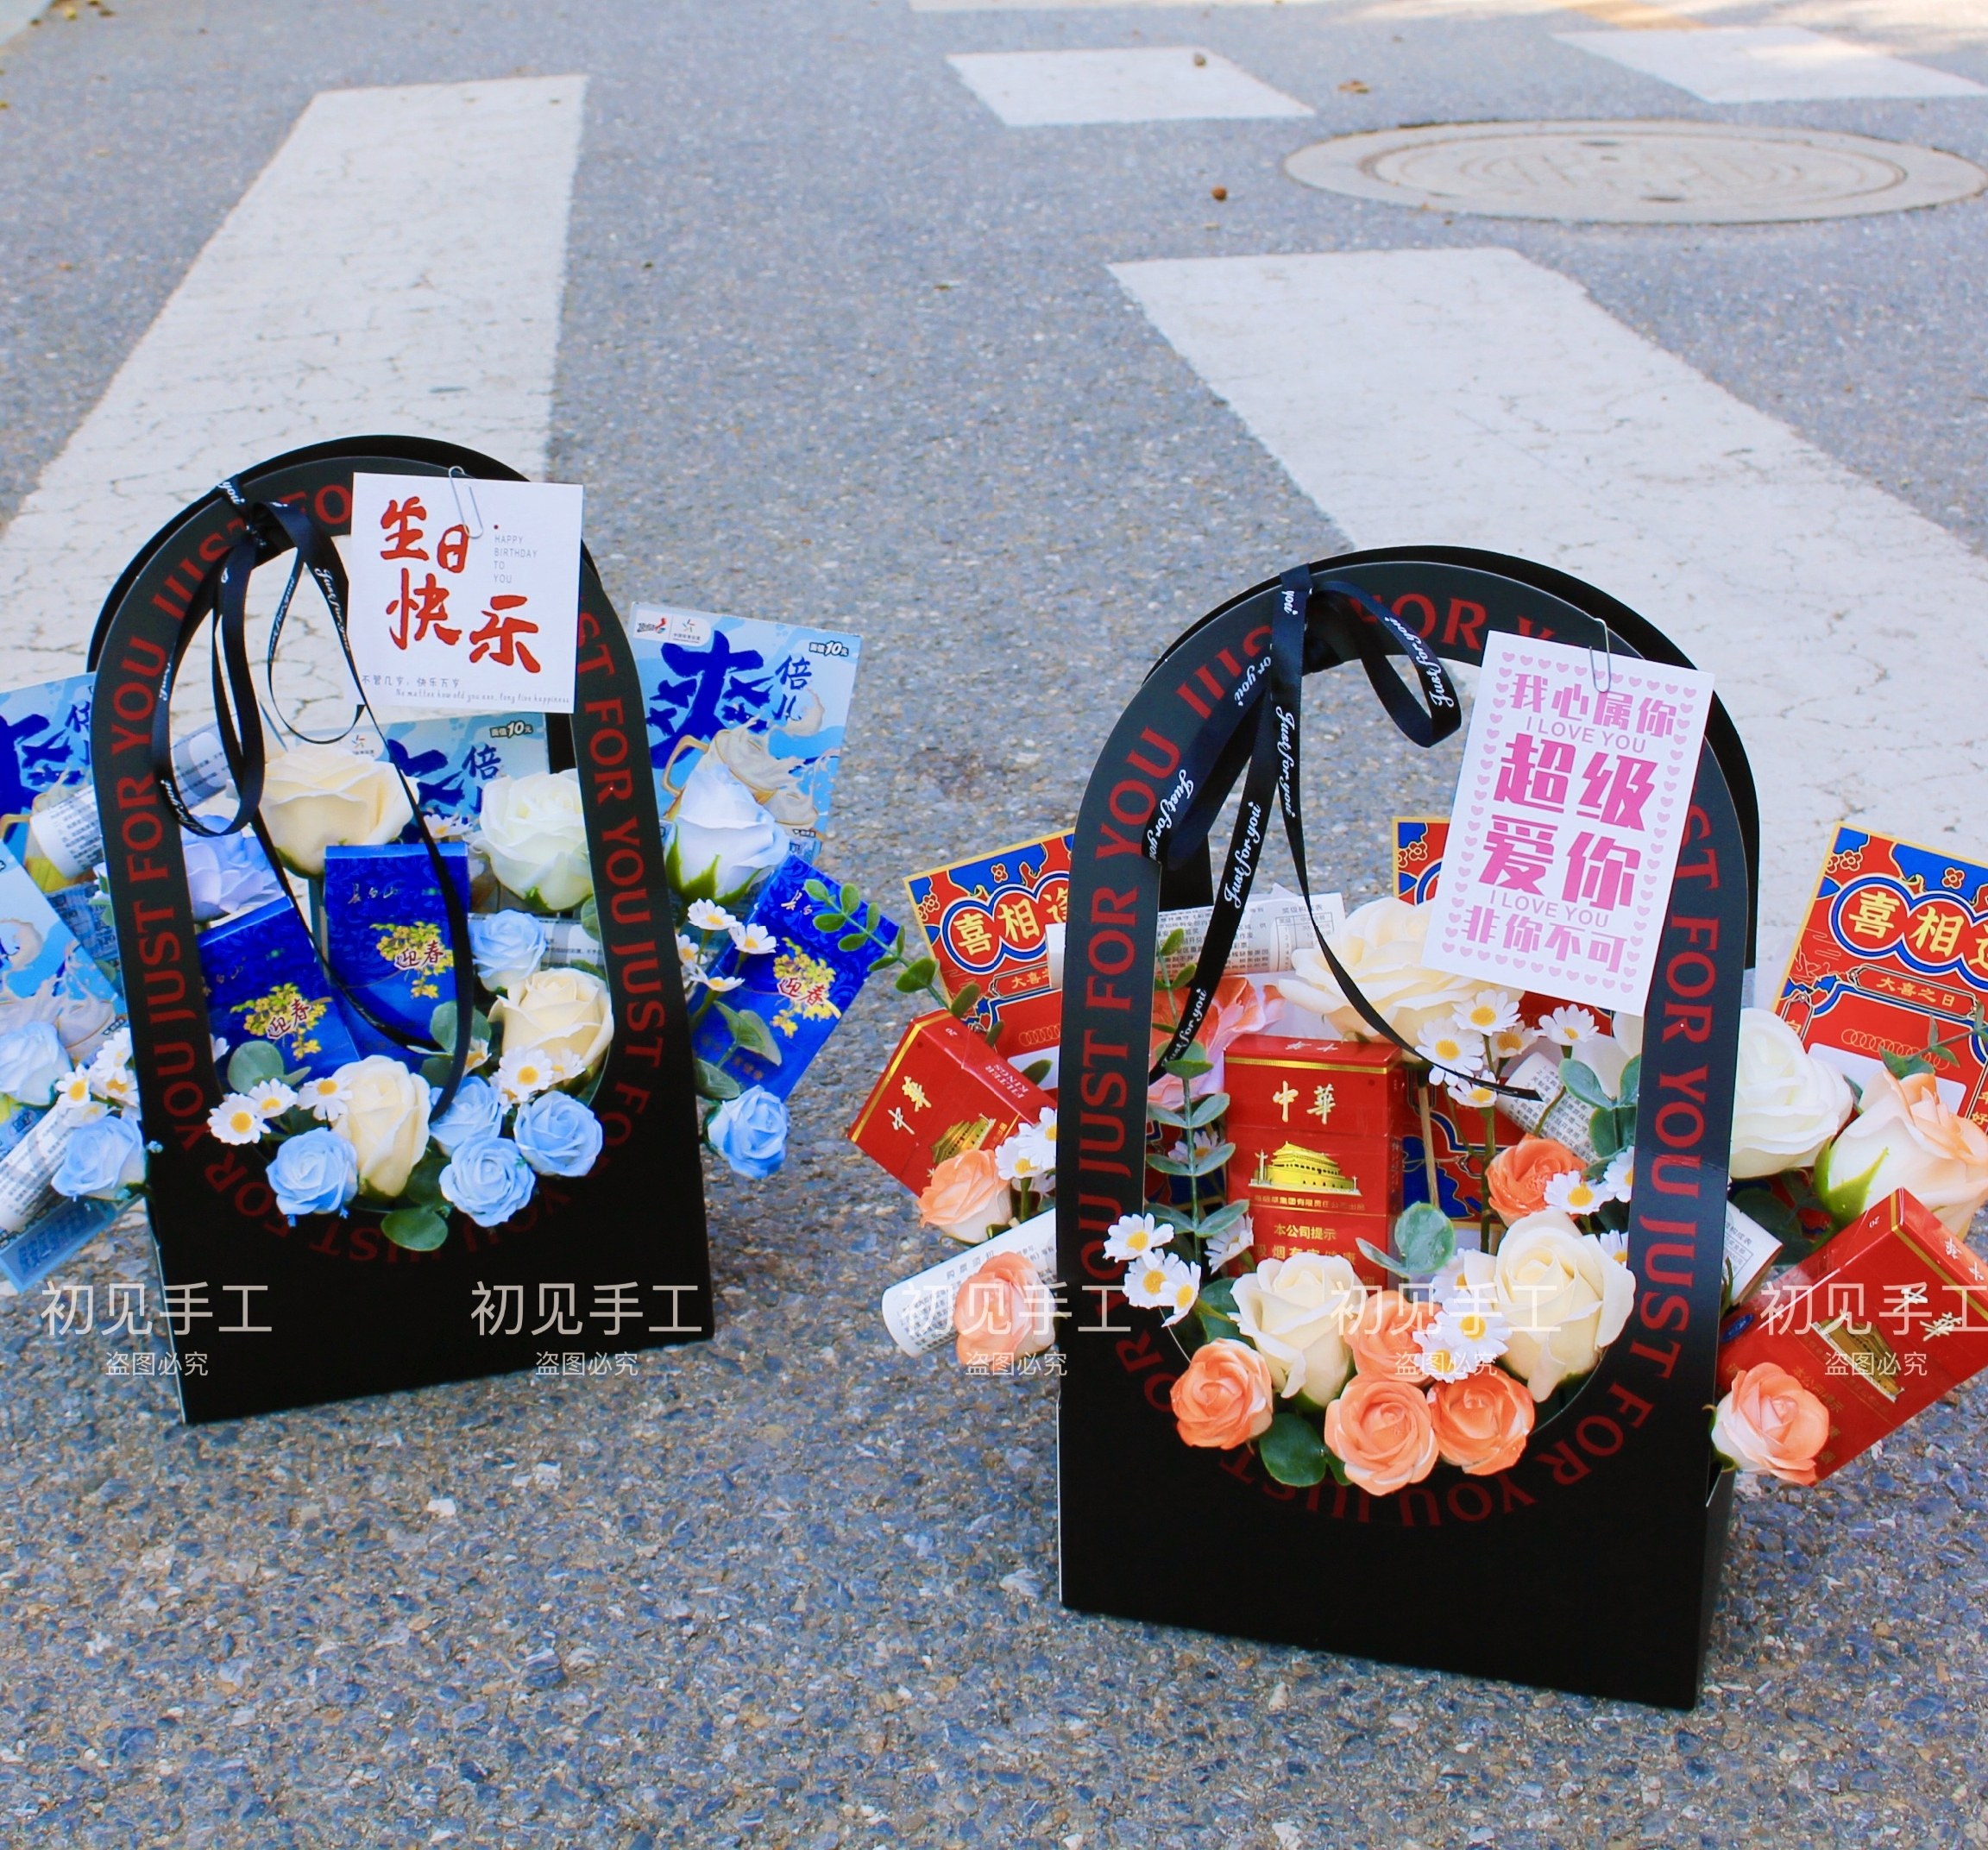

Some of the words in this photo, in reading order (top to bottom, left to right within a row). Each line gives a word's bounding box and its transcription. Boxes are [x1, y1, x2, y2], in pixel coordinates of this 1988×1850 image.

[381, 496, 469, 573] 生日
[494, 534, 523, 544] HAPPY
[494, 547, 538, 558] BIRTHDAY
[494, 560, 505, 569] TO
[494, 573, 512, 583] YOU
[386, 568, 541, 673] 快乐
[1282, 589, 1298, 616] you
[1412, 643, 1442, 674] for
[110, 636, 167, 755] YOU
[406, 689, 435, 698] matter
[453, 691, 464, 700] old
[467, 693, 480, 702] you
[500, 692, 515, 704] long
[518, 693, 532, 702] live
[534, 694, 570, 704] happiness
[1235, 665, 1257, 706] you
[1426, 669, 1455, 708] Just
[1508, 672, 1678, 737] 我心属你
[584, 696, 633, 806] FOR
[1276, 706, 1295, 751] Just
[1525, 716, 1532, 732] I
[1538, 718, 1594, 744] LOVE
[1601, 731, 1646, 753] YOU
[1277, 739, 1294, 780] for
[1494, 733, 1658, 833] 超级
[1095, 725, 1182, 860] YOU
[1167, 770, 1194, 813] Just
[1279, 777, 1296, 817] you
[116, 772, 171, 883] FOR
[1155, 799, 1173, 838] for
[601, 815, 653, 928] YOU
[1224, 867, 1245, 909] Just
[1235, 838, 1251, 876] for
[1247, 802, 1261, 844] you
[1478, 815, 1642, 912] 爱你
[1489, 890, 1496, 905] I
[1501, 892, 1557, 919] LOVE
[1564, 905, 1610, 929] YOU
[133, 899, 198, 1025] JUST
[394, 940, 444, 970] 迎春
[1085, 885, 1139, 1010] FOR
[1462, 905, 1628, 974] 非你不可
[611, 937, 665, 1069] JUST
[777, 977, 827, 1007] 迎春
[1662, 916, 1720, 1043] FOR
[1876, 976, 1955, 1008] 大喜之日
[267, 997, 311, 1039] 迎春
[1180, 1019, 1194, 1048] for
[1192, 990, 1207, 1022] you
[153, 1041, 211, 1152] YOU
[994, 1064, 1029, 1093] KINGS
[1079, 1029, 1133, 1179] JUST
[1649, 1064, 1708, 1199] YOU
[1274, 1224, 1336, 1241] 本公司提示
[1629, 1215, 1698, 1379] JUST
[1534, 1381, 1655, 1488] FOR
[1399, 1475, 1538, 1528] YOU
